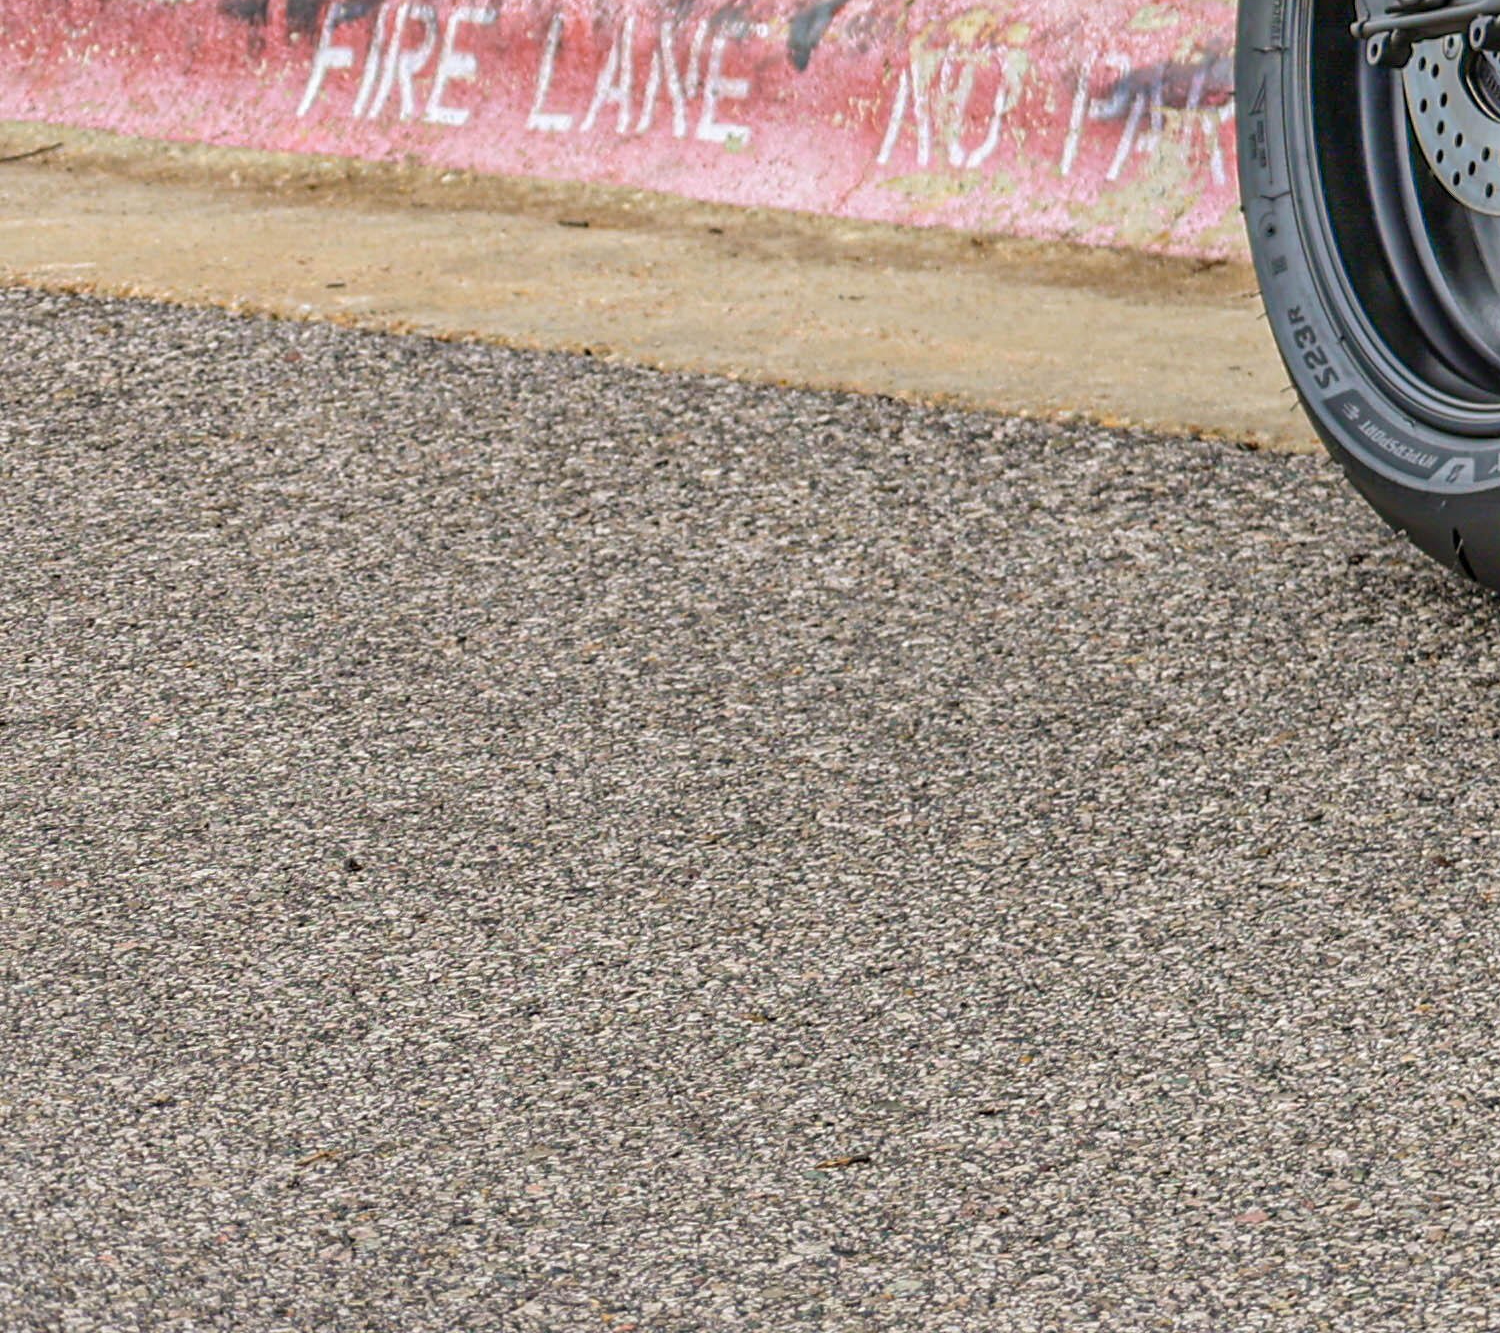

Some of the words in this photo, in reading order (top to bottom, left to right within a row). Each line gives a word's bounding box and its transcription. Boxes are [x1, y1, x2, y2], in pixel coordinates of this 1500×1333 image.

[527, 13, 768, 146] LANE
[1286, 305, 1340, 391] S23R
[1356, 418, 1438, 470] HYPERSPORT
